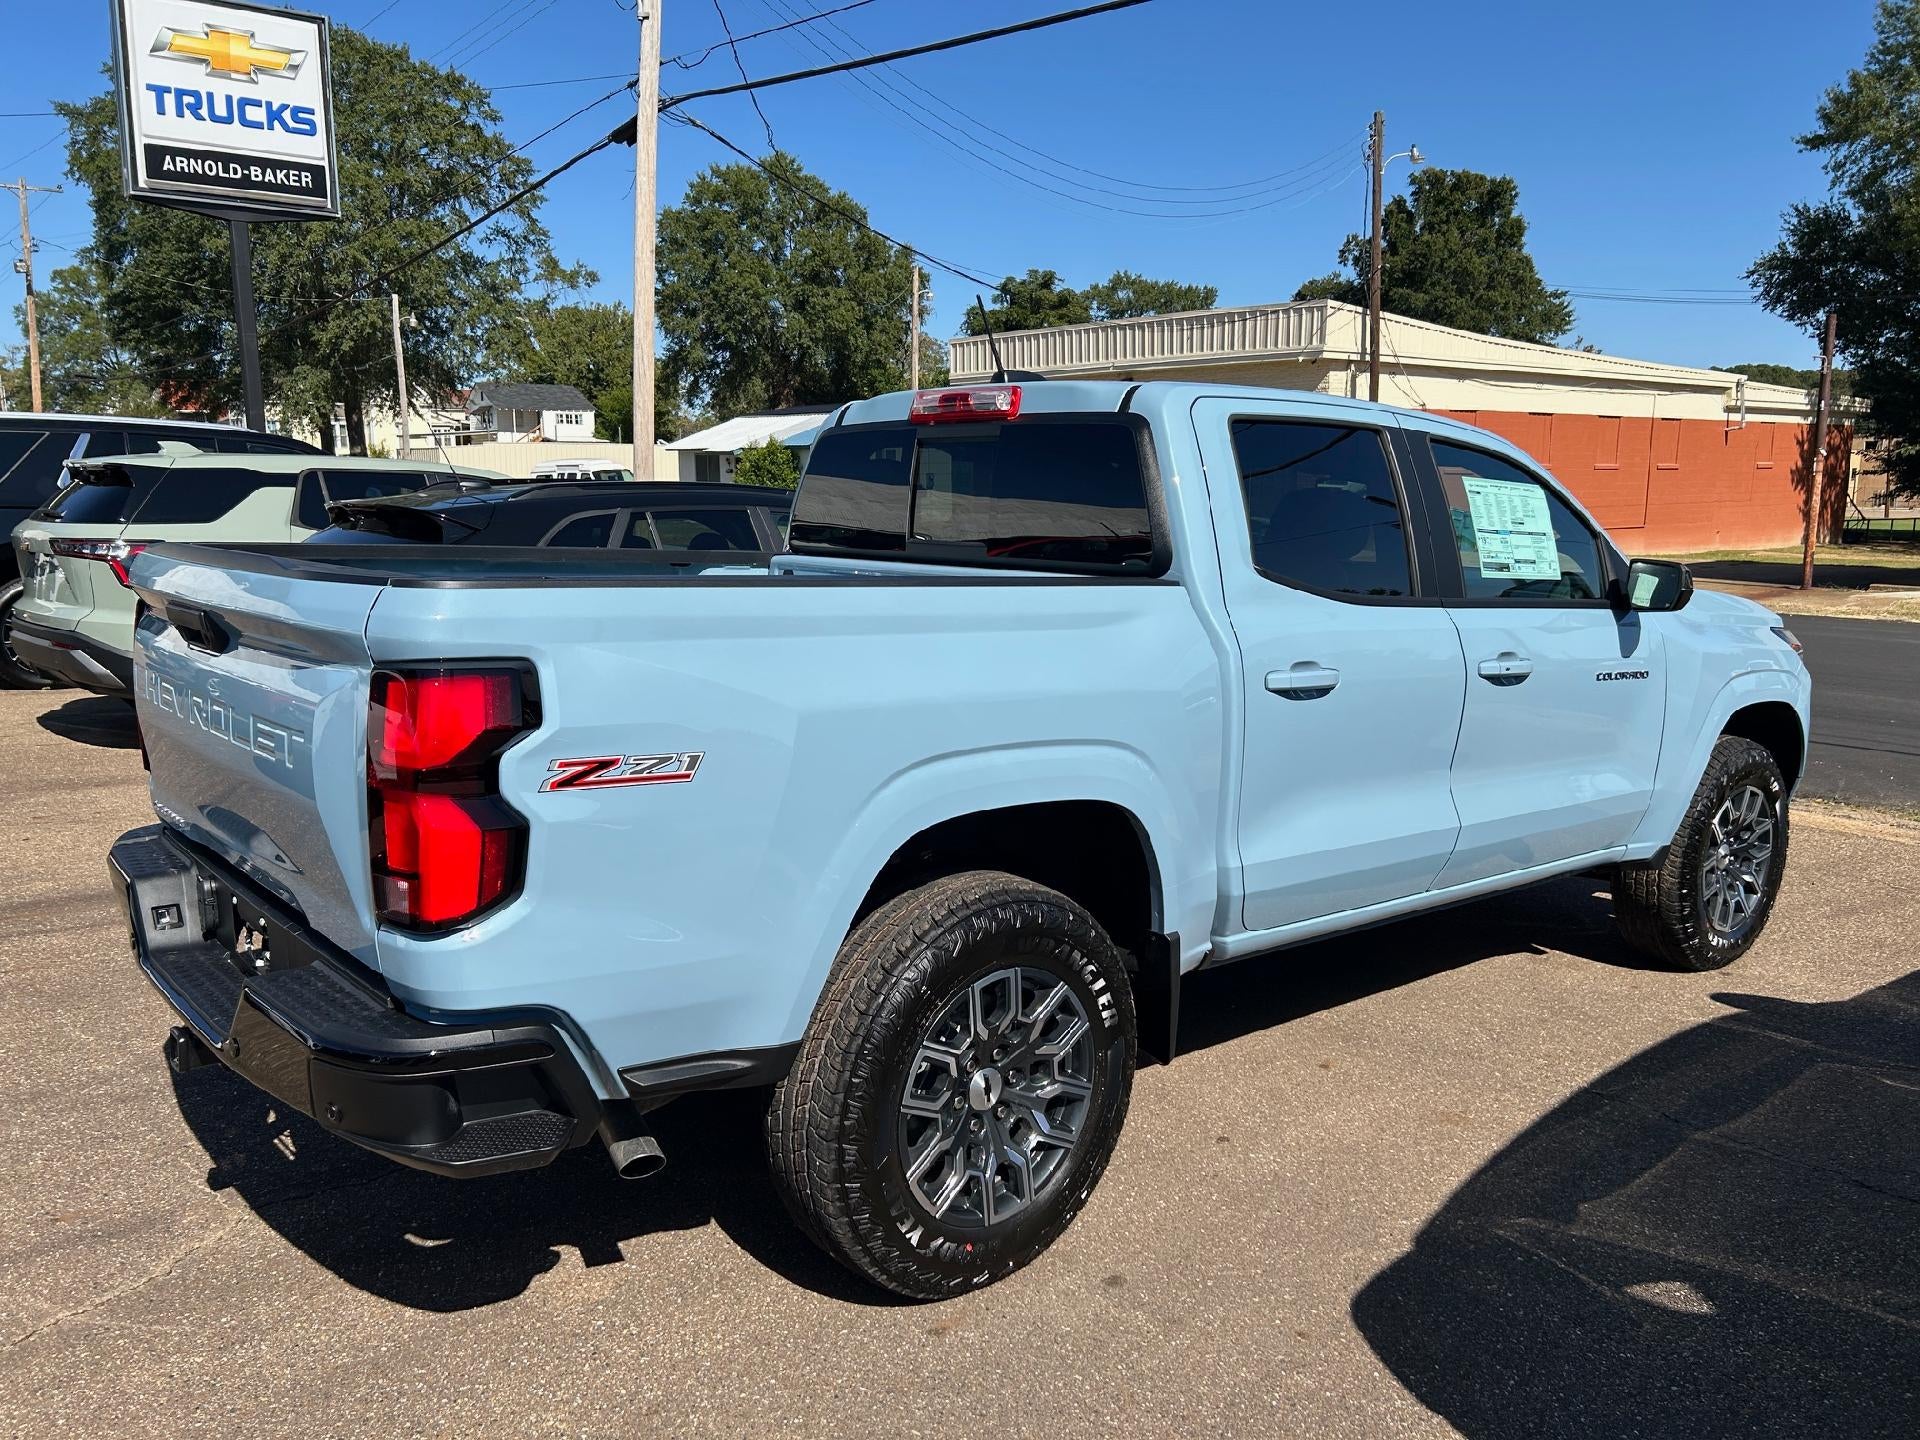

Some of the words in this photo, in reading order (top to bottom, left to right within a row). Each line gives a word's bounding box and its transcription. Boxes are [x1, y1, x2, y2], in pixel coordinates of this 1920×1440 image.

[146, 83, 318, 137] TRUCKS
[162, 154, 313, 188] ARNOLD-BAKER
[1595, 670, 1649, 682] COLORADO
[538, 751, 706, 793] Z71
